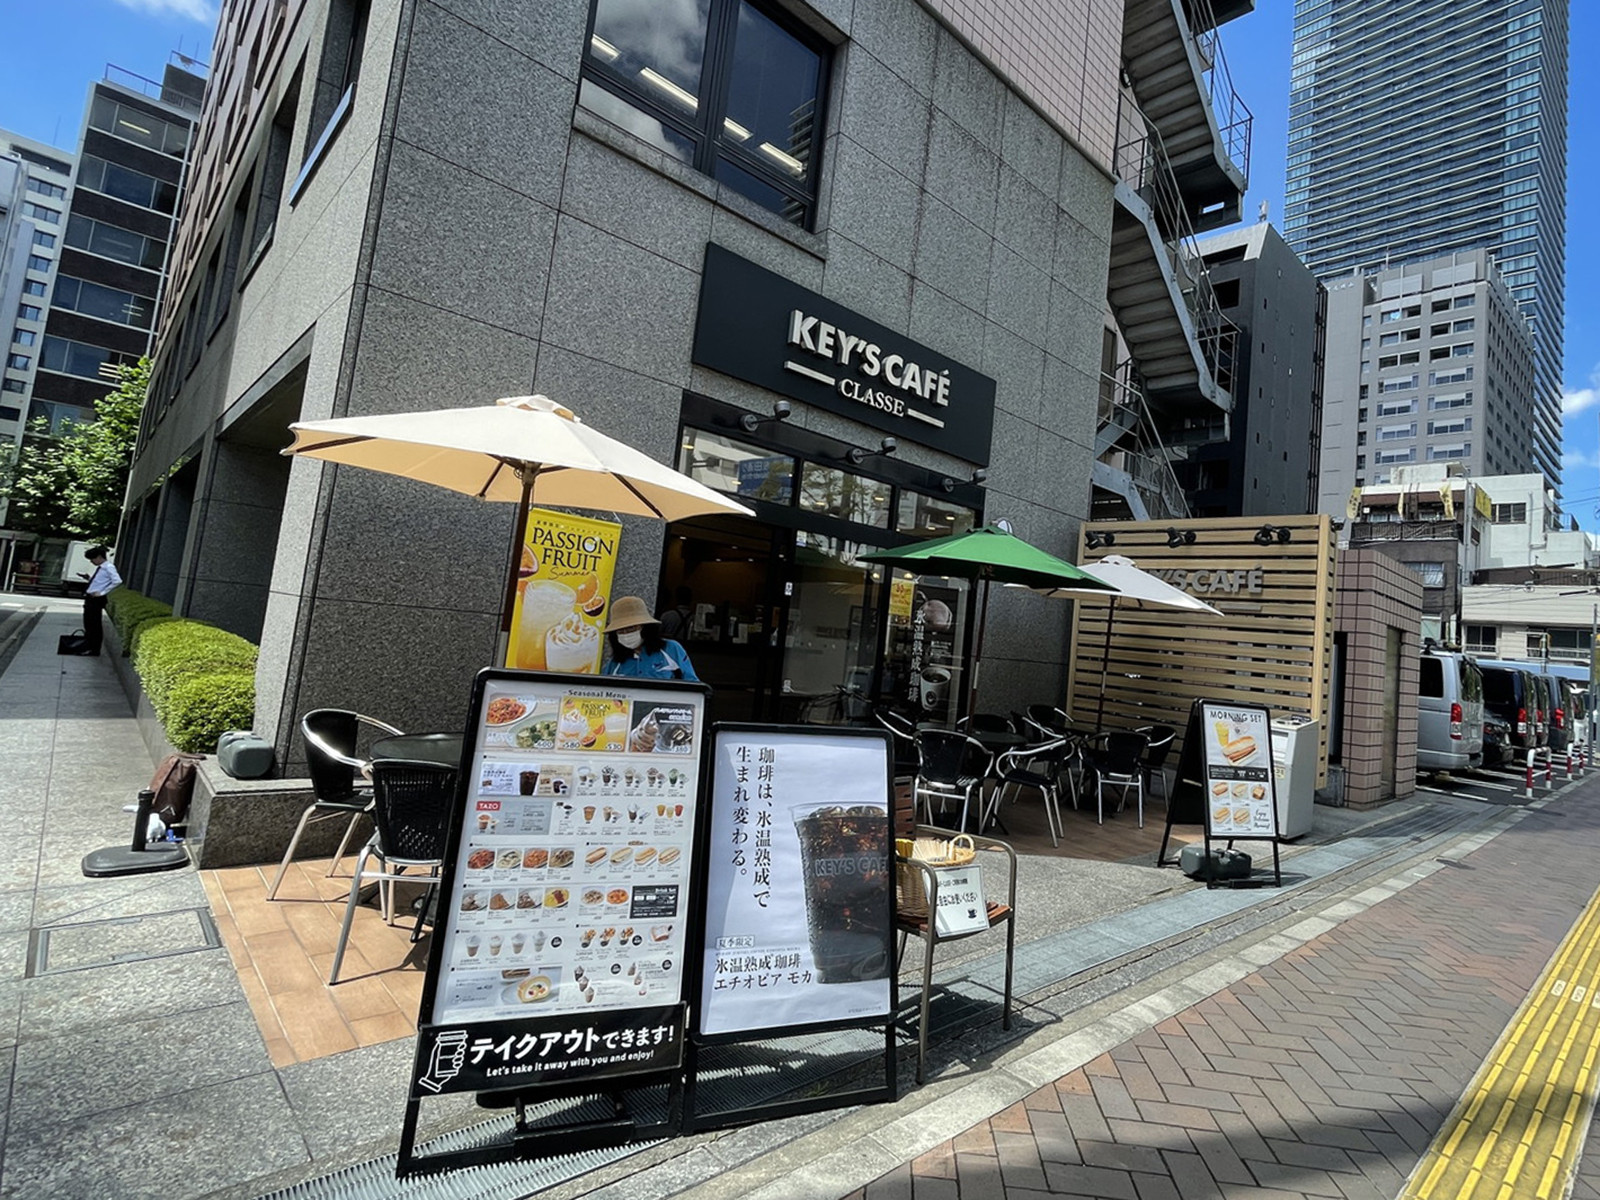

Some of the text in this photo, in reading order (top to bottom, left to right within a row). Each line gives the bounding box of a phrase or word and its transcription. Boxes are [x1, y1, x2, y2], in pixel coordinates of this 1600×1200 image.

[788, 309, 951, 406] KEY'S CAFÉ
[839, 377, 905, 417] CLASSE
[531, 526, 614, 556] PASSION
[541, 547, 602, 572] FRUIT
[548, 566, 591, 581] Summer
[1191, 564, 1264, 594] CAFÉ
[568, 689, 603, 698] Seasonal
[1210, 711, 1262, 723] MORNING SET
[731, 746, 751, 876] 生まれ変わる。
[753, 747, 775, 908] 珈琲は、氷温熟成で
[815, 858, 856, 877] KEY'S
[715, 953, 801, 974] 氷温熟成珈琲
[714, 970, 812, 990] エチオピア モカ
[470, 1025, 674, 1064] テイクアウトできます!
[486, 1050, 654, 1077] Let's take it away with you and enjoy!
